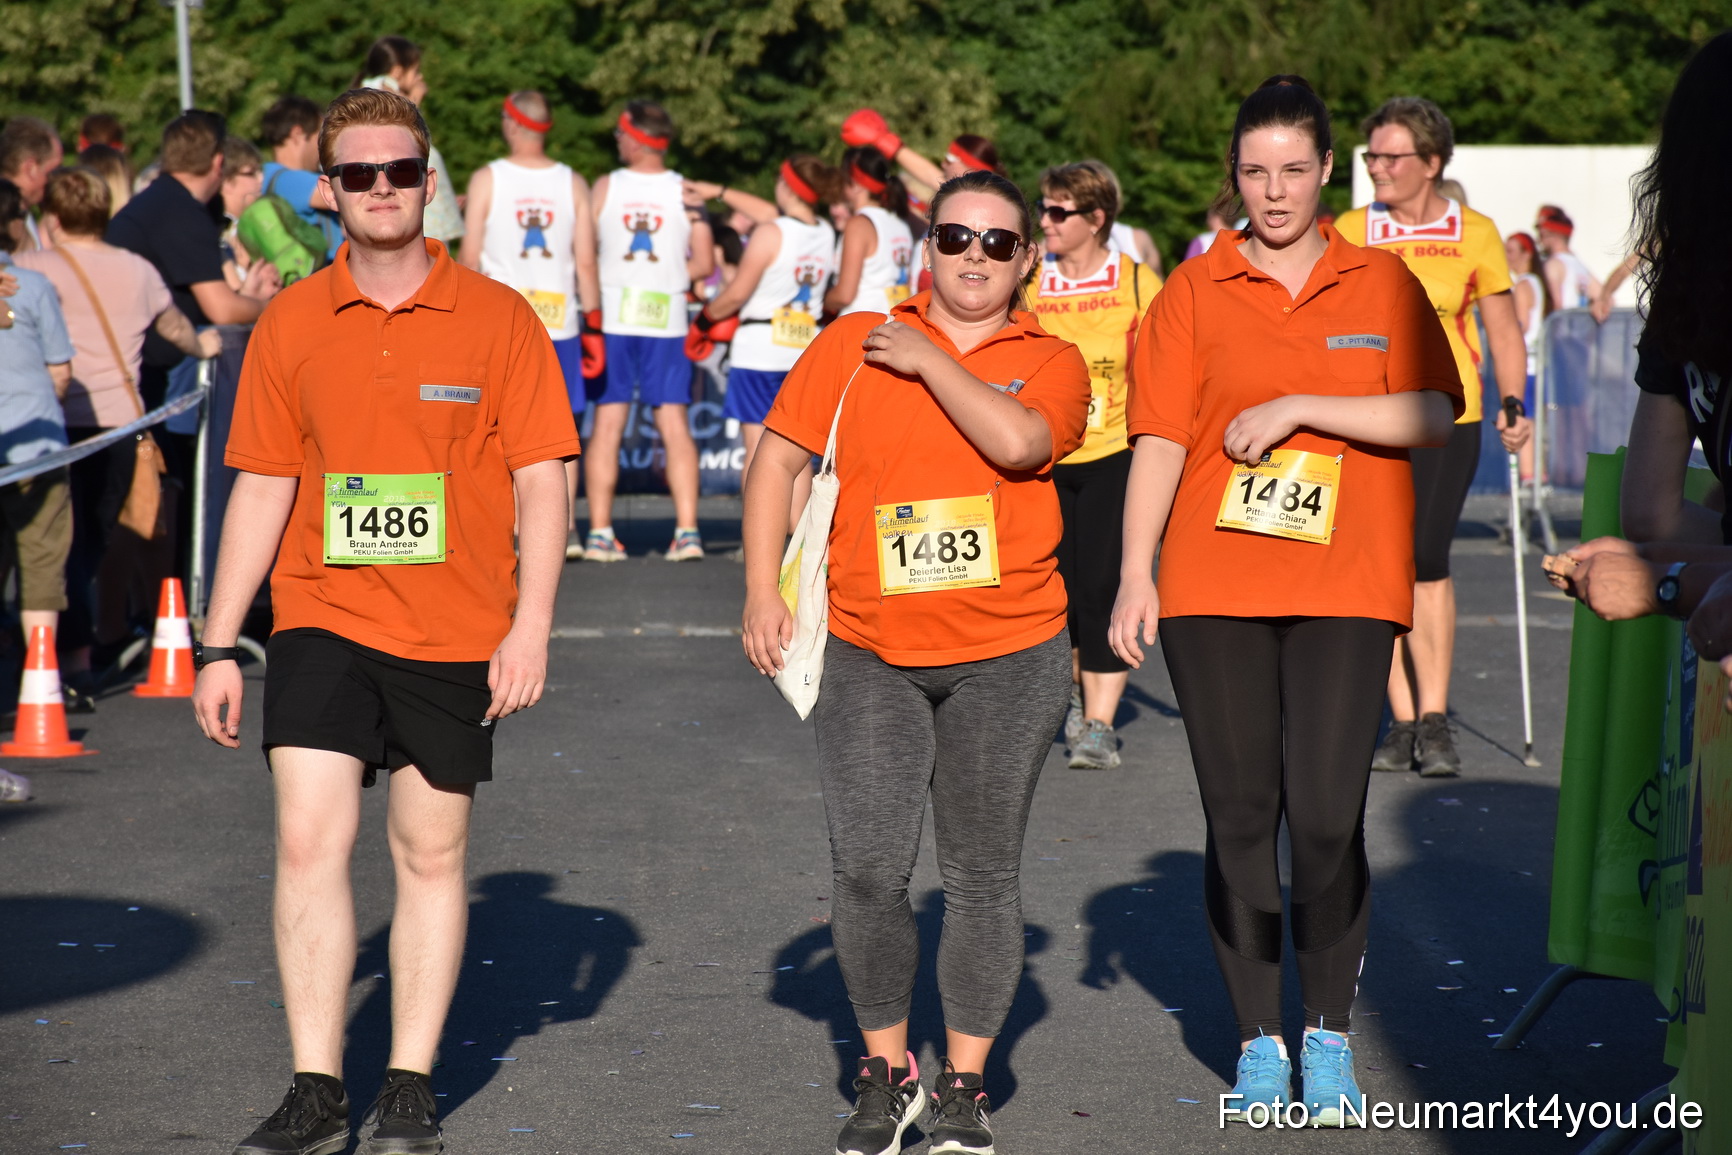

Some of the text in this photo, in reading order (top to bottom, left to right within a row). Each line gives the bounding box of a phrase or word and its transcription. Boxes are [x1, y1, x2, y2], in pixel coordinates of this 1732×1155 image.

[1414, 244, 1462, 257] BÖGL
[1035, 297, 1120, 314] MAX BÖGL
[338, 487, 379, 497] firmenlauf
[1240, 476, 1322, 516] 1484
[339, 506, 429, 538] 1486
[889, 514, 929, 526] firmenlauf
[1245, 506, 1307, 525] Pittana Chiara
[1246, 516, 1303, 531] PEKU Folien GmbH
[349, 540, 418, 548] Braun Andreas
[892, 529, 981, 567] 1483
[909, 565, 967, 576] Deierler Lisa
